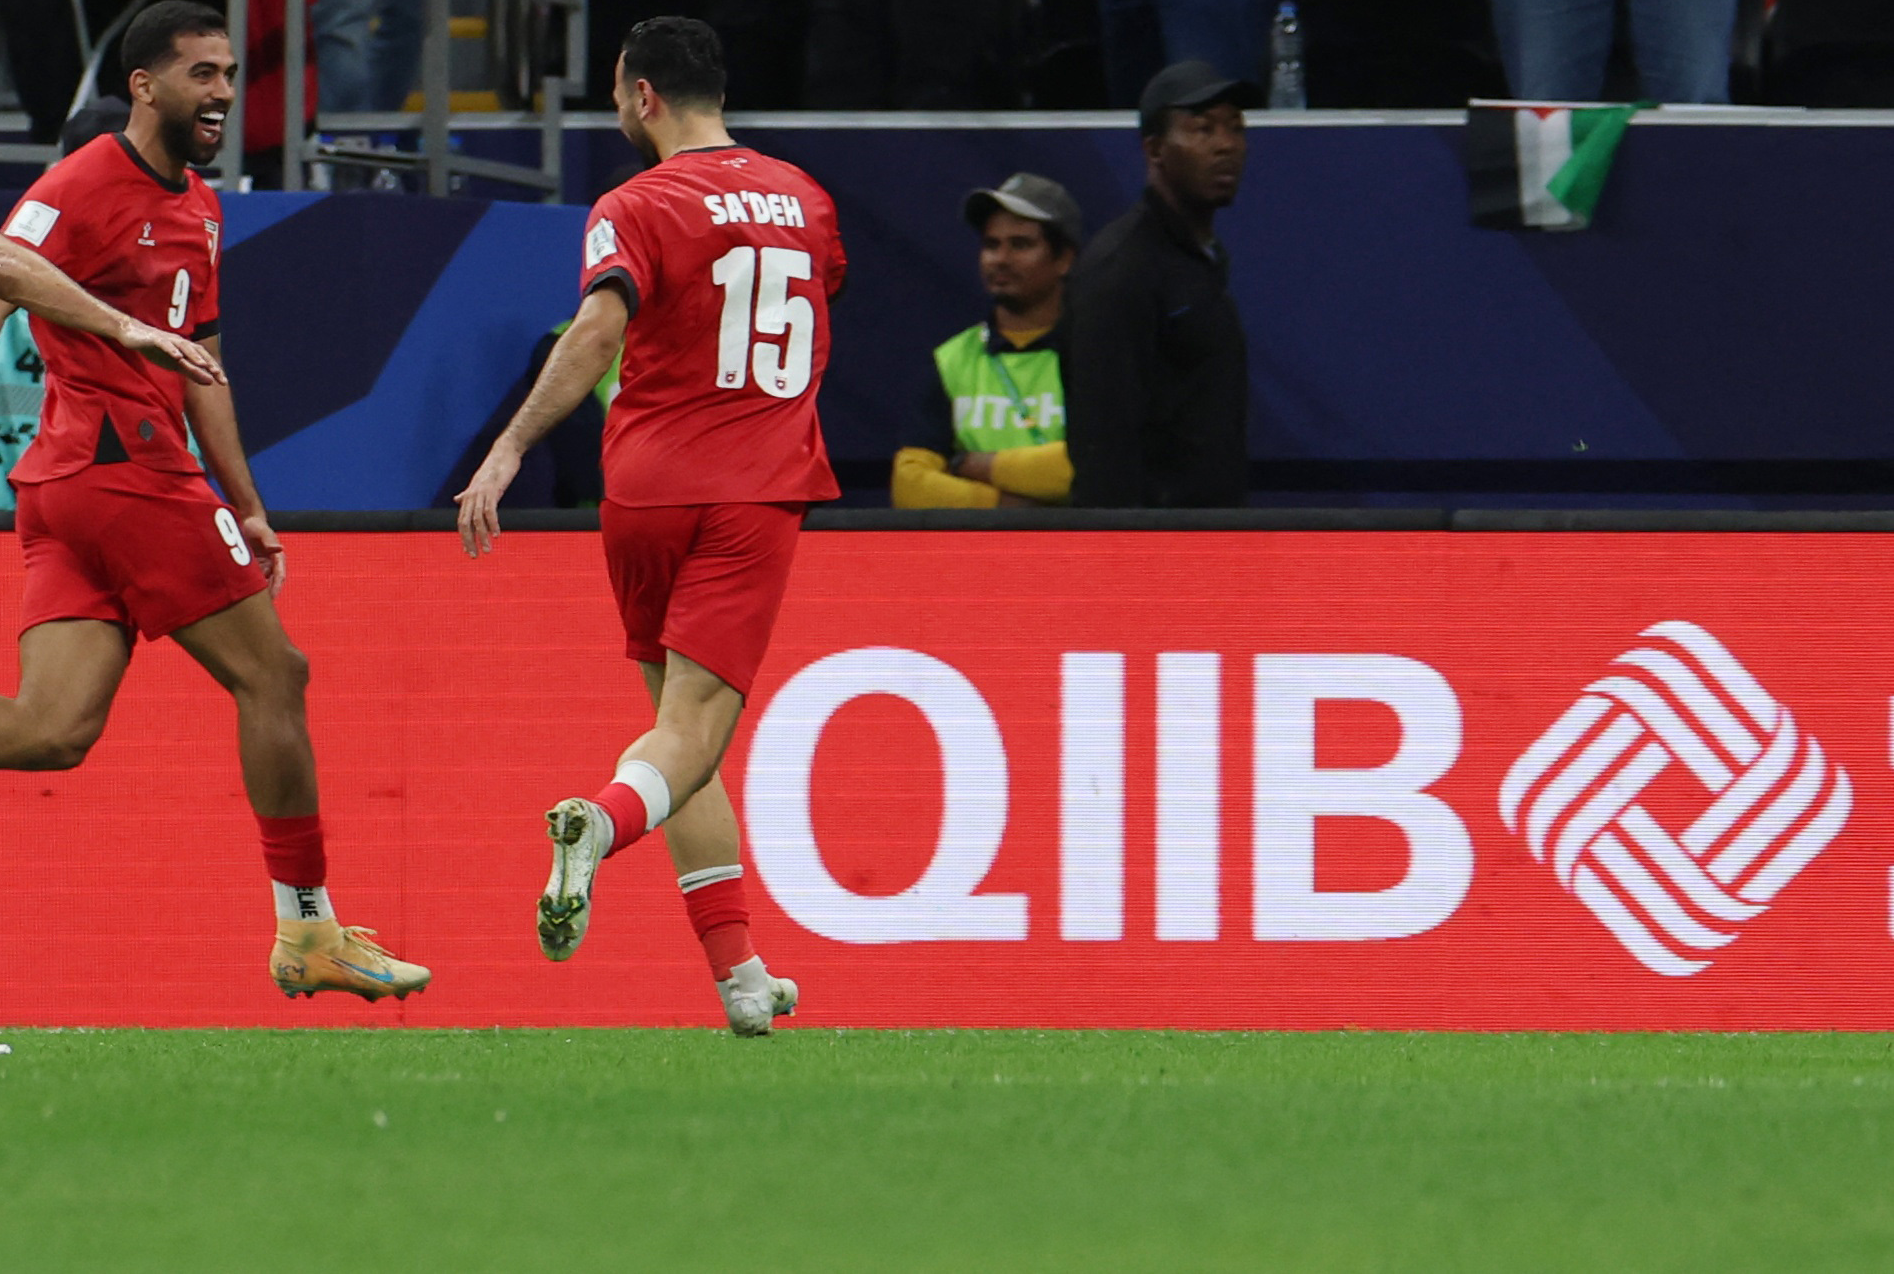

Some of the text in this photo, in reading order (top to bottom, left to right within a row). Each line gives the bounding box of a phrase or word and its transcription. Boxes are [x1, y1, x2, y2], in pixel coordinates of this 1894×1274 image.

[704, 190, 805, 228] SA'DEH
[167, 268, 190, 329] 9
[712, 245, 815, 399] 15
[213, 506, 253, 567] 9
[743, 645, 1477, 945] QIIB
